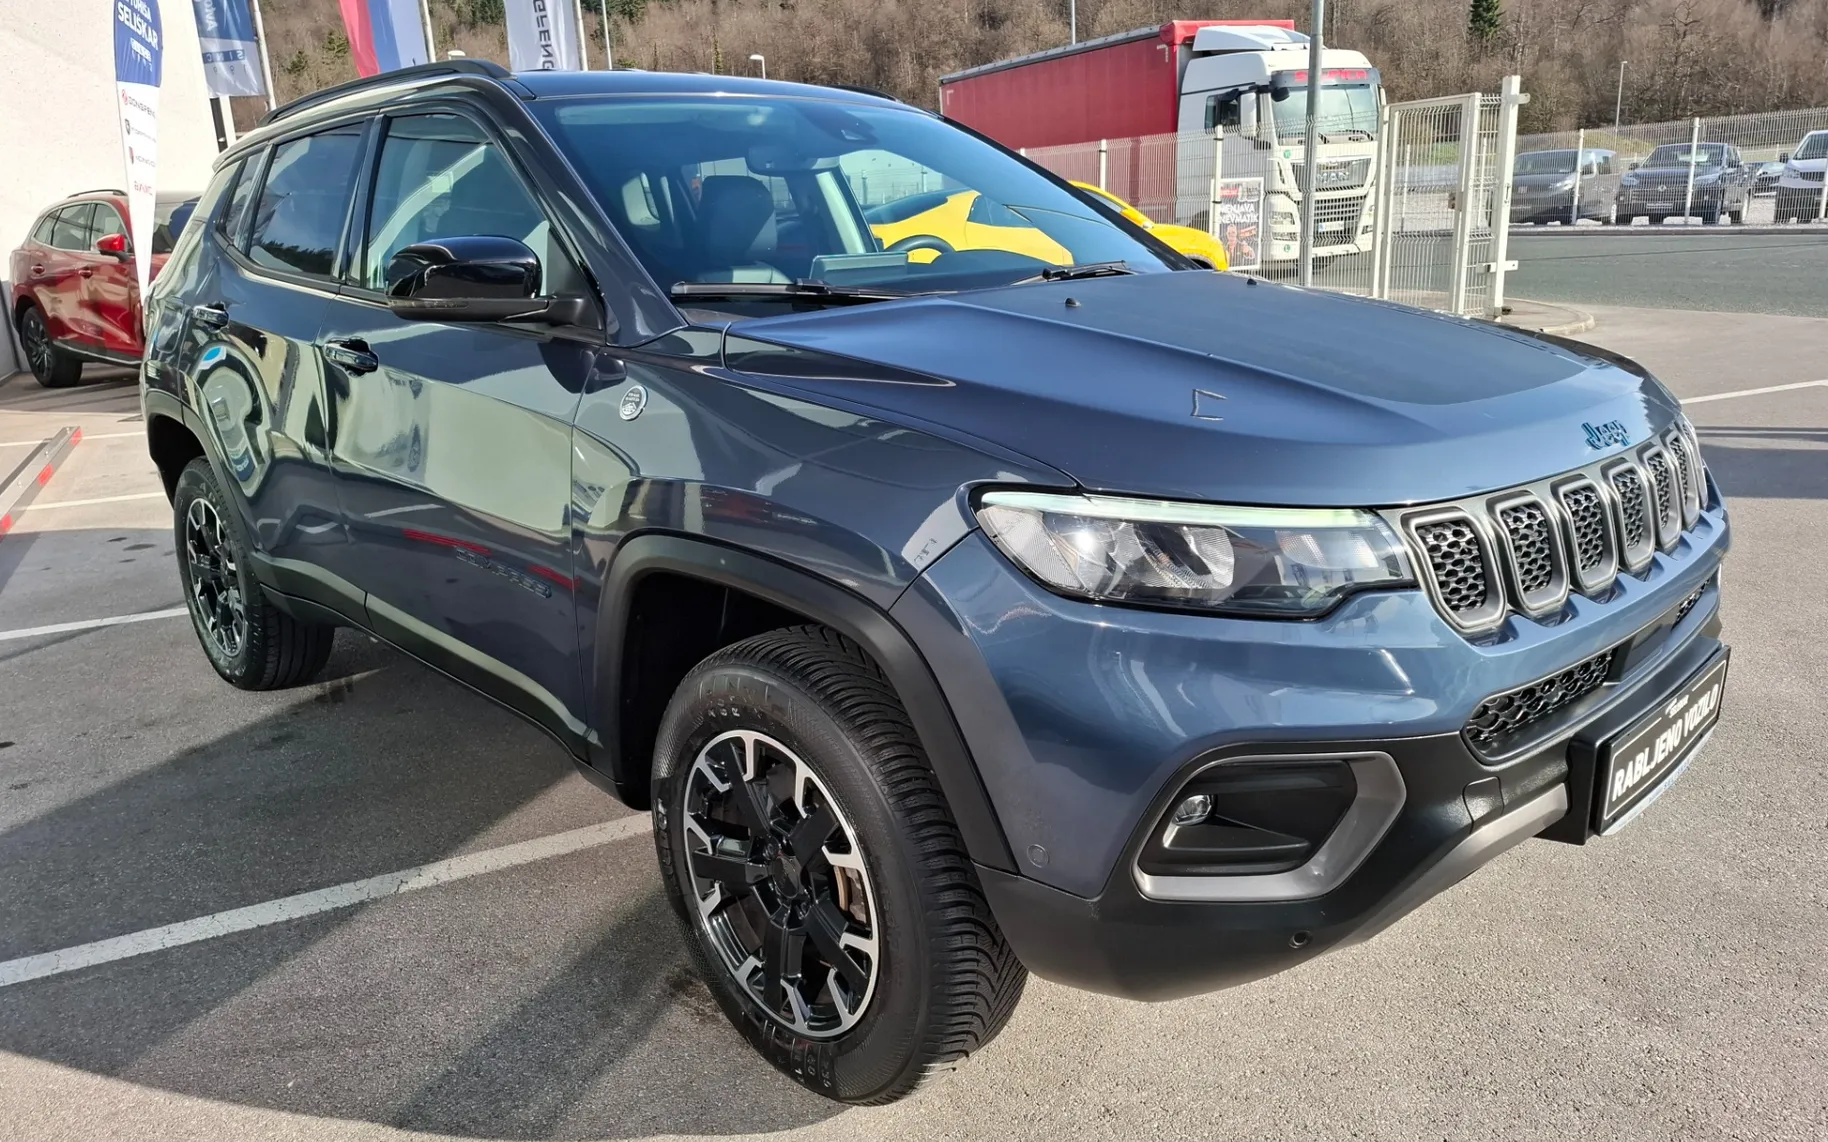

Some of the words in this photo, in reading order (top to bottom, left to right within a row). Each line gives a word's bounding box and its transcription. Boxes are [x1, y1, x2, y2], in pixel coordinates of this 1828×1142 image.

[1316, 170, 1350, 184] MAN
[1581, 420, 1629, 450] Jeep
[1612, 718, 1683, 802] RABLJENO
[1684, 683, 1719, 737] VOZILO
